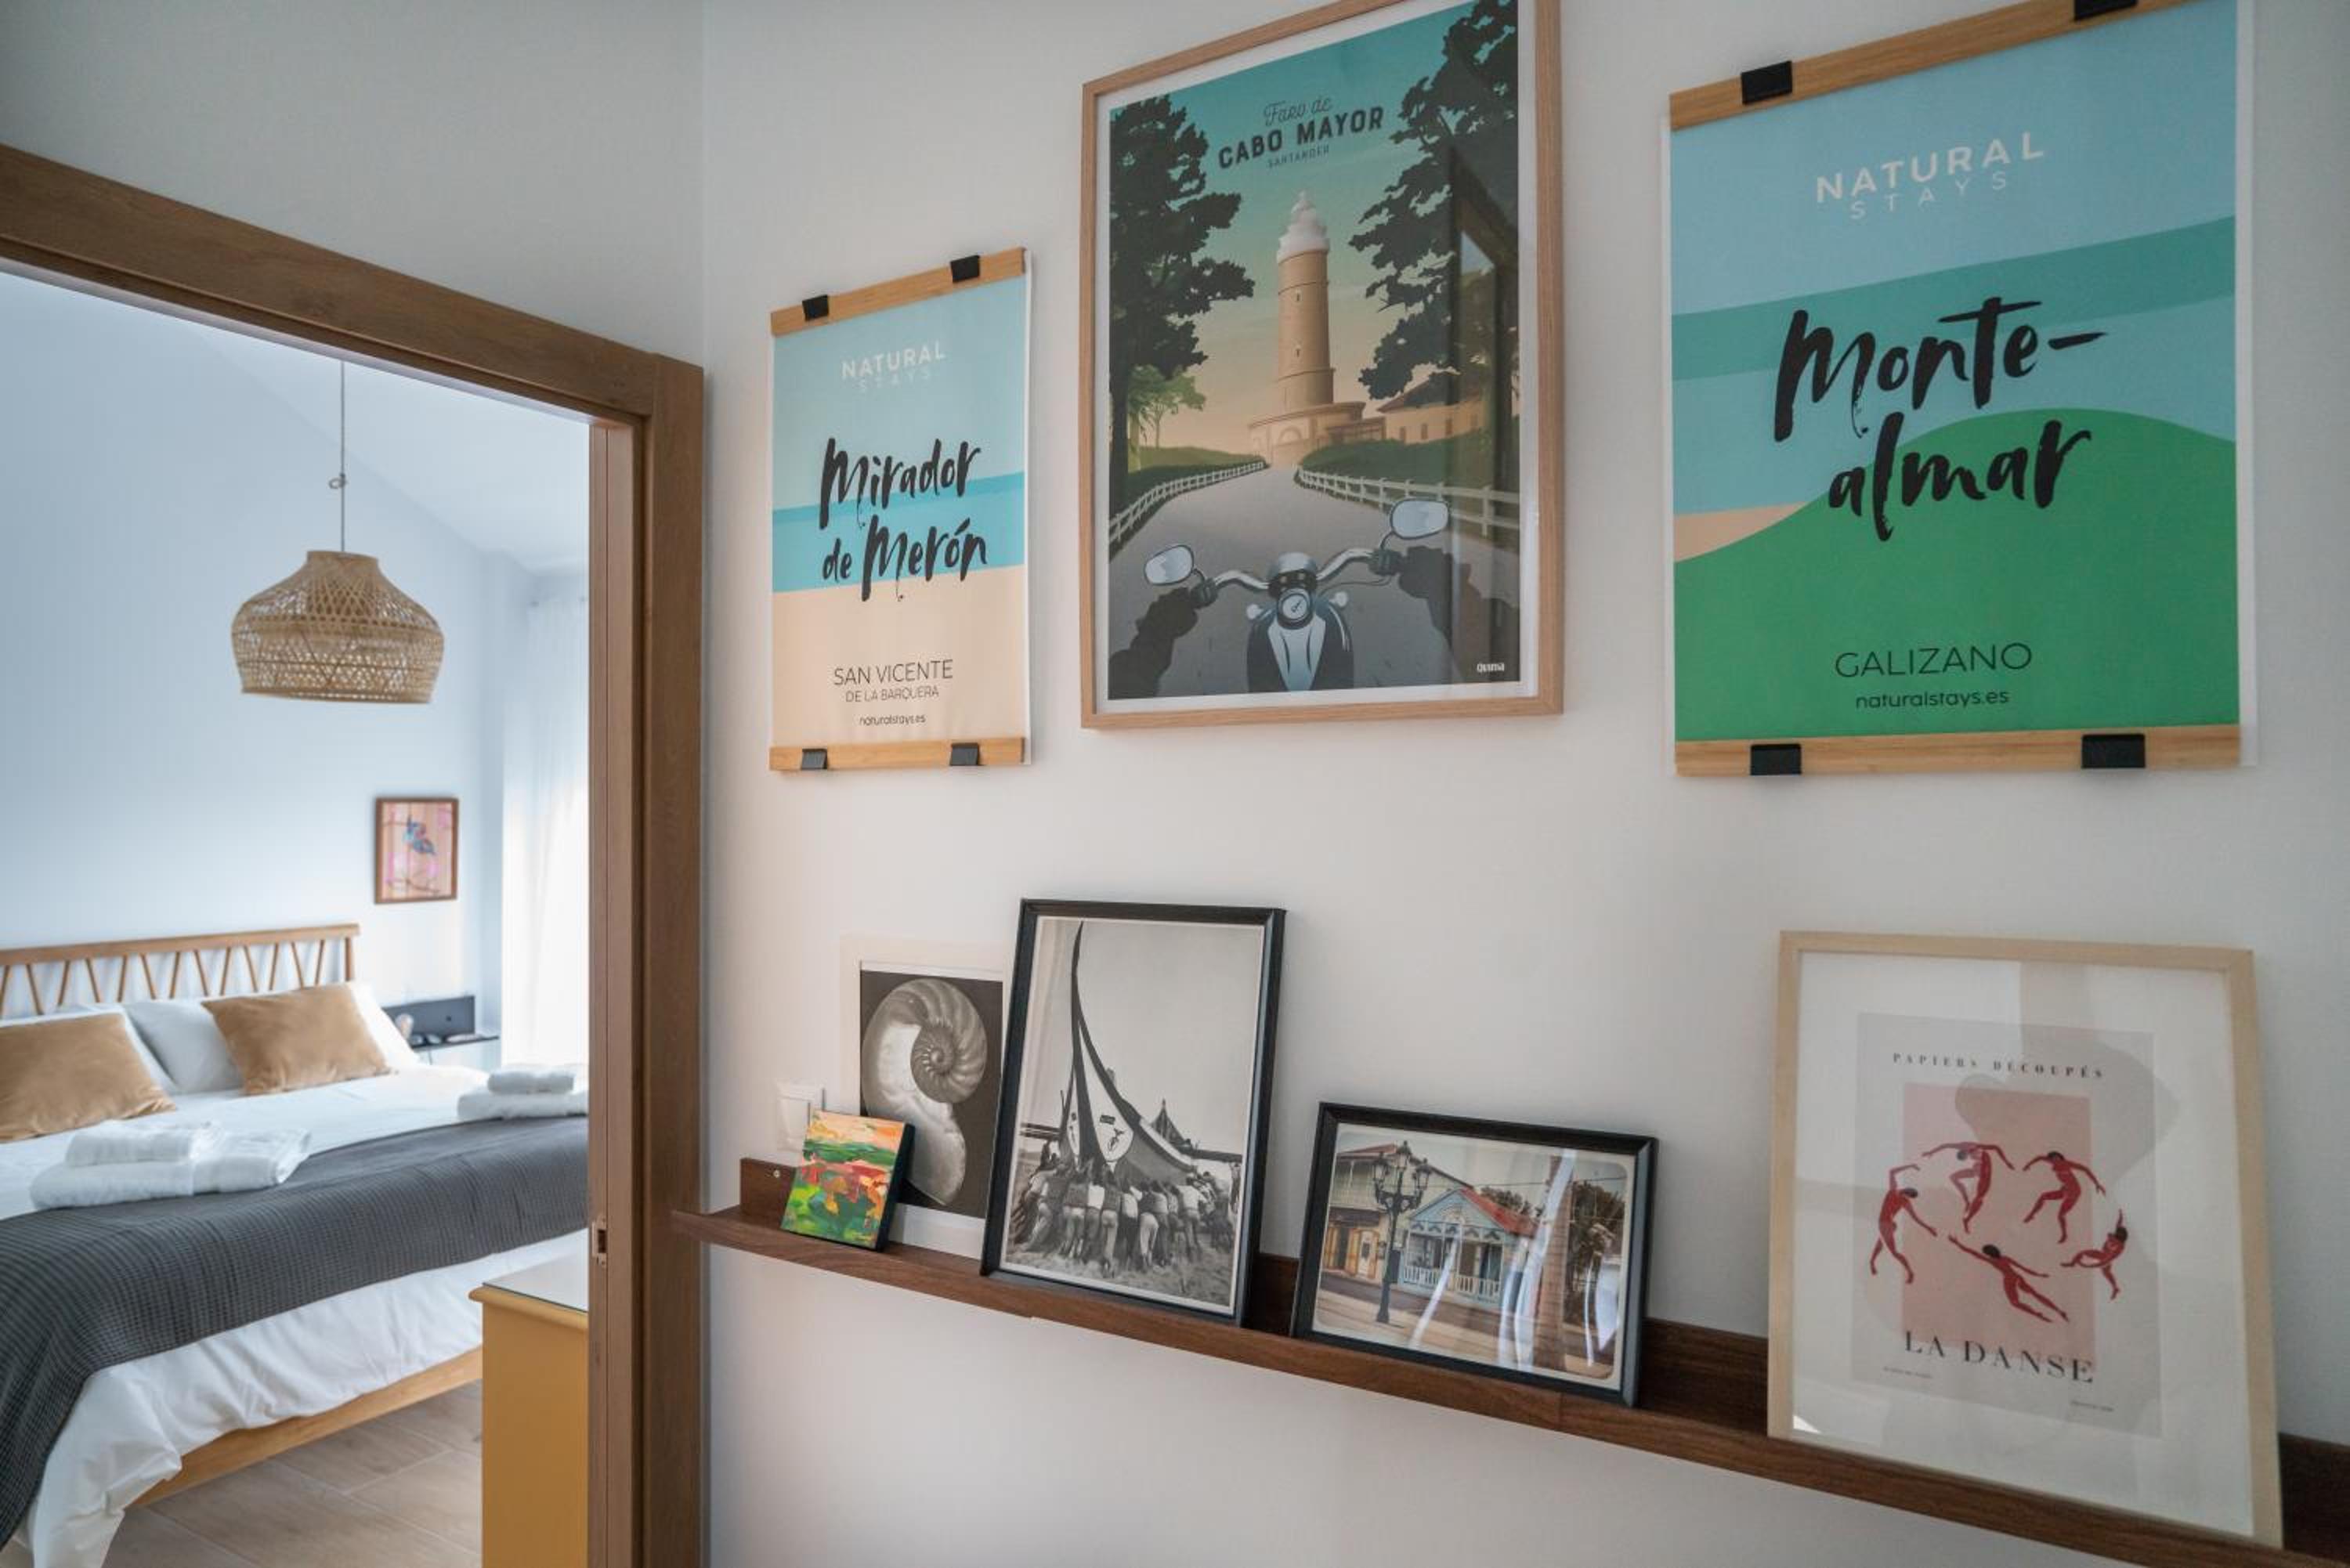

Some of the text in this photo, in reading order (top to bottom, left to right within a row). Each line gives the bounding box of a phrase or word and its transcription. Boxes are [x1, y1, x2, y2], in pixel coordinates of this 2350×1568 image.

[1263, 96, 1332, 126] Faro de
[1218, 107, 1384, 169] CABO MAYOR
[1268, 144, 1330, 168] SANTANDER
[1817, 132, 2044, 204] NATURAL
[1849, 171, 2006, 220] STAYS
[841, 340, 945, 381] NATURAL
[859, 368, 930, 392] STAYS
[1773, 297, 2107, 442] Monte-
[819, 437, 981, 529] Mirador
[1828, 411, 2092, 542] almar
[822, 515, 987, 602] de Merón
[833, 659, 953, 686] SAN VICENTE
[1835, 642, 2032, 678] GALIZANO
[845, 685, 940, 703] DE LA BARQUERA
[1855, 690, 2010, 709] naturalstays.es
[1893, 1053, 1977, 1068] PAPIERS
[1905, 1330, 2094, 1384] LA DANSE
